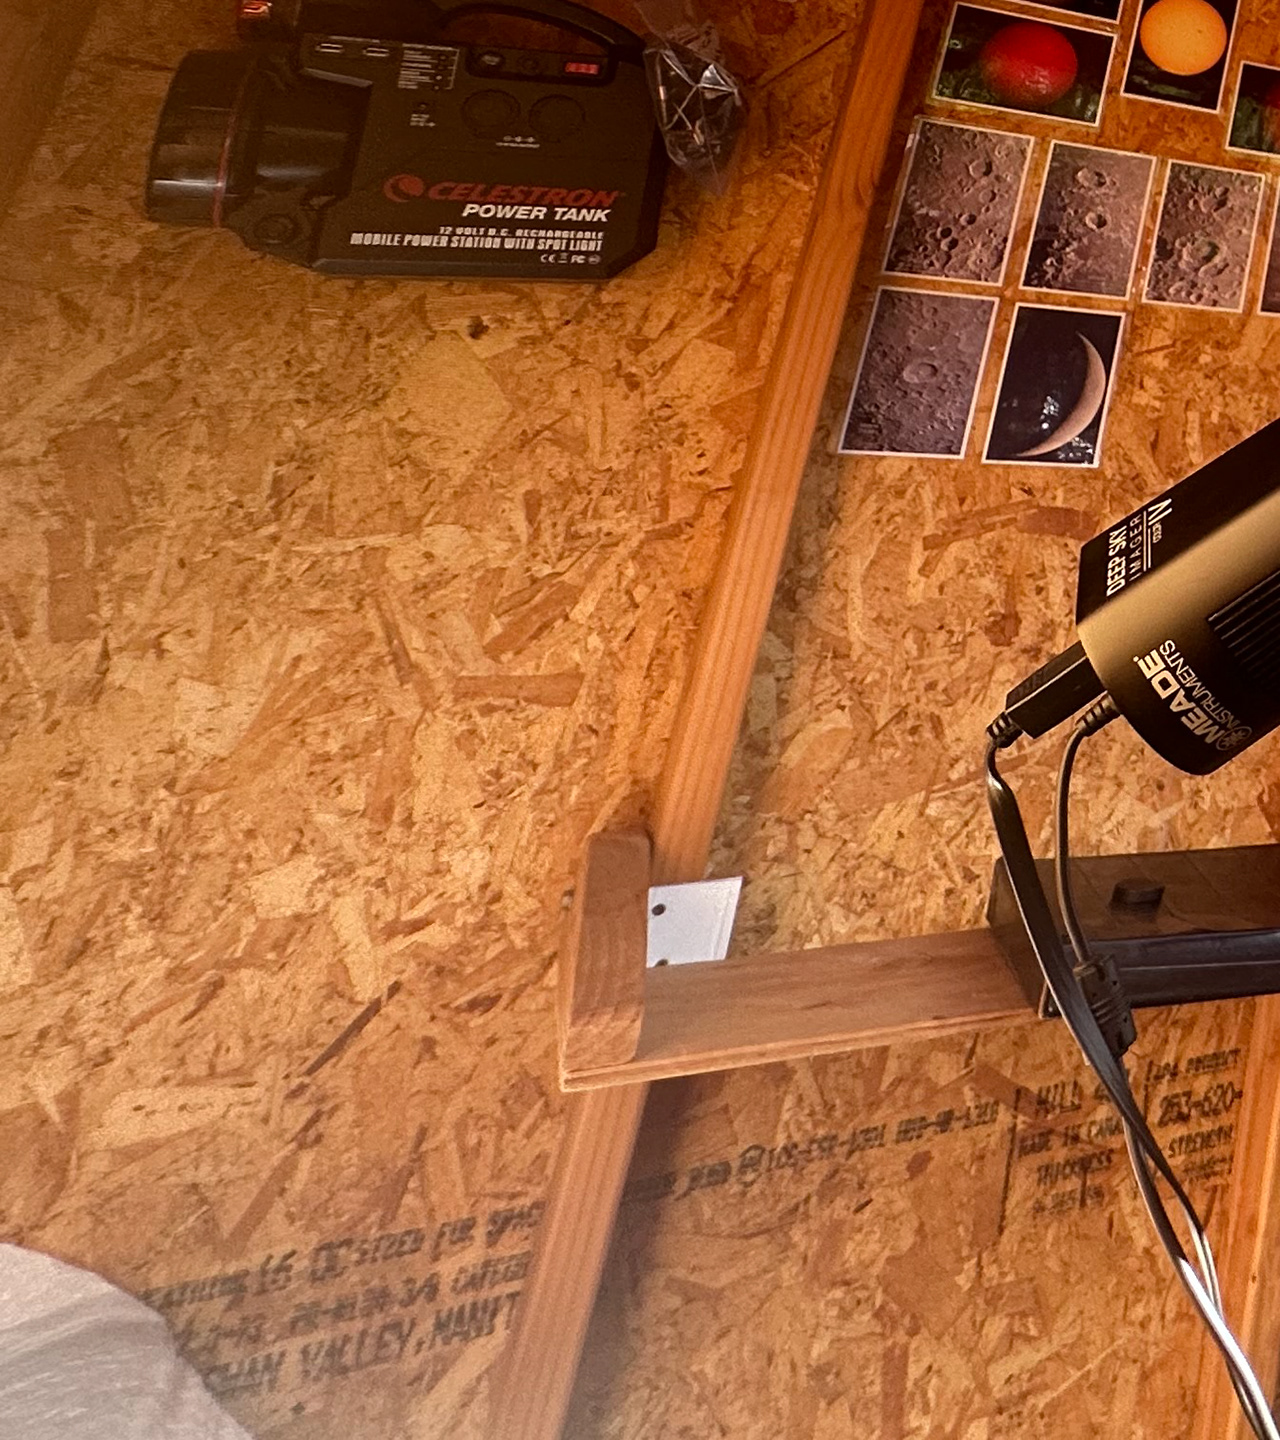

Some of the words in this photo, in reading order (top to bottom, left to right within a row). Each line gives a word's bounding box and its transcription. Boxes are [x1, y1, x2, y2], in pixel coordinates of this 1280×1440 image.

[428, 181, 619, 208] CELESTRON
[461, 203, 547, 220] POWER
[553, 207, 612, 222] TANK
[350, 232, 401, 245] MOBILE
[402, 234, 449, 248] POWER
[450, 236, 501, 249] STATION
[503, 237, 536, 250] WITH
[537, 238, 567, 252] SPOT
[569, 240, 603, 253] LIGHT
[439, 226, 453, 235] 12
[455, 226, 484, 236] VOLT
[515, 228, 605, 240] RECHARGEABLE
[1147, 498, 1172, 526] IV
[1108, 525, 1128, 556] SKY
[1129, 514, 1142, 581] IMAGER
[1106, 556, 1126, 596] DEEP
[1135, 649, 1225, 744] MEADE
[1160, 640, 1240, 728] INSTRUMENTS
